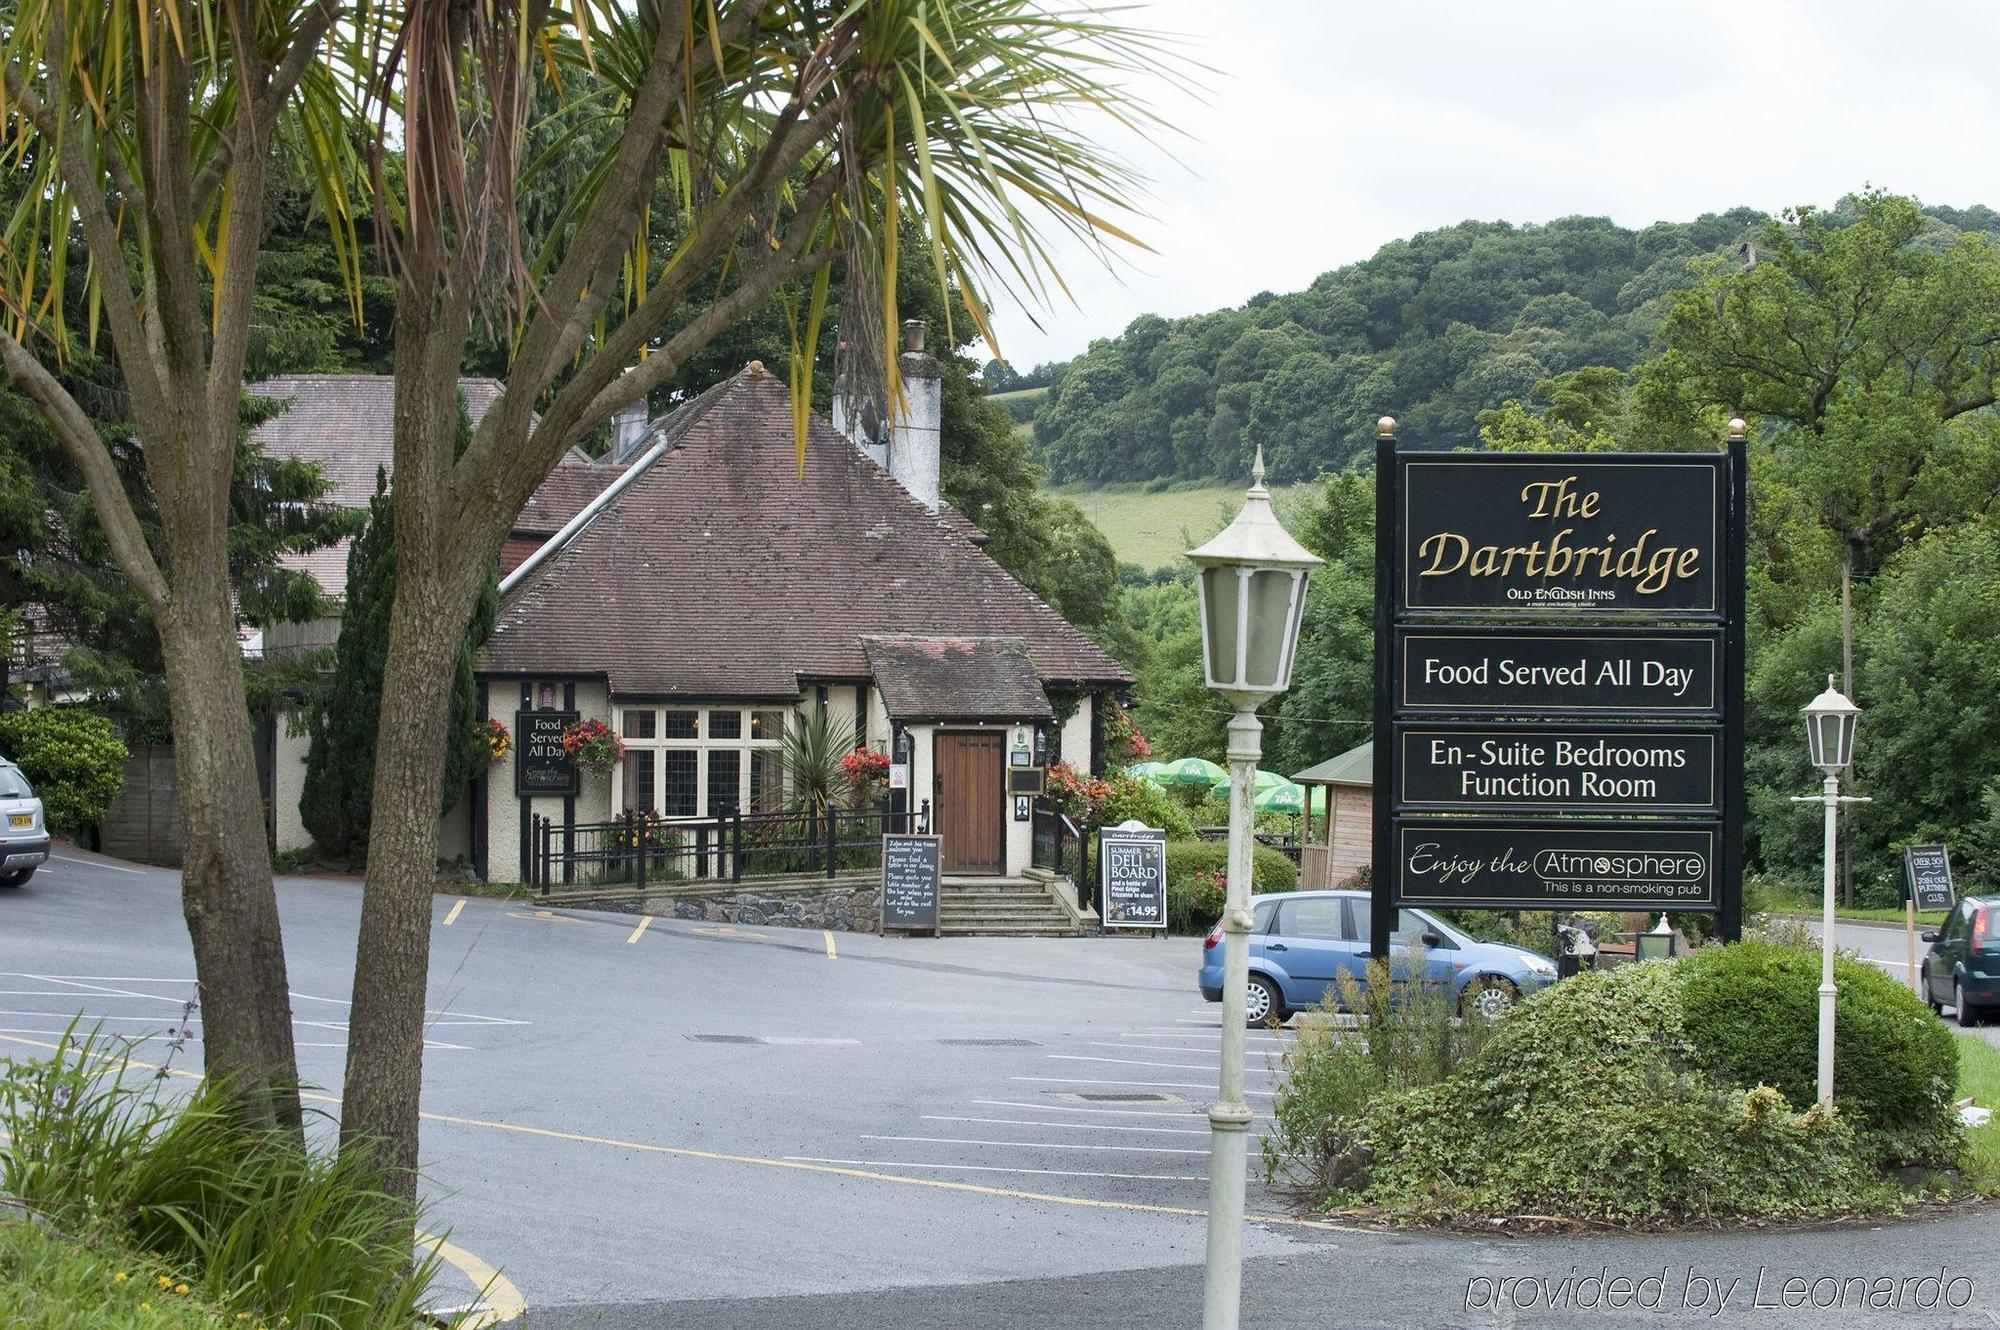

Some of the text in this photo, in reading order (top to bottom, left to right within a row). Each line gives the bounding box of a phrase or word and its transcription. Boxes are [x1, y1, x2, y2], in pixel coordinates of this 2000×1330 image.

[1521, 476, 1601, 519] The
[1418, 528, 1700, 595] Dartbridge
[1424, 657, 1693, 696] Food Served All Day
[535, 719, 561, 730] Food
[528, 746, 567, 760] All Day
[1555, 740, 1686, 768] Bedrooms
[1461, 770, 1656, 798] Function Room
[1111, 855, 1143, 867] DELI
[1408, 843, 1702, 884] Enjoy the Atmosphere
[1111, 867, 1158, 879] BOARD
[1543, 881, 1701, 897] This is a non-smoking pub
[1126, 905, 1158, 917] £14.95
